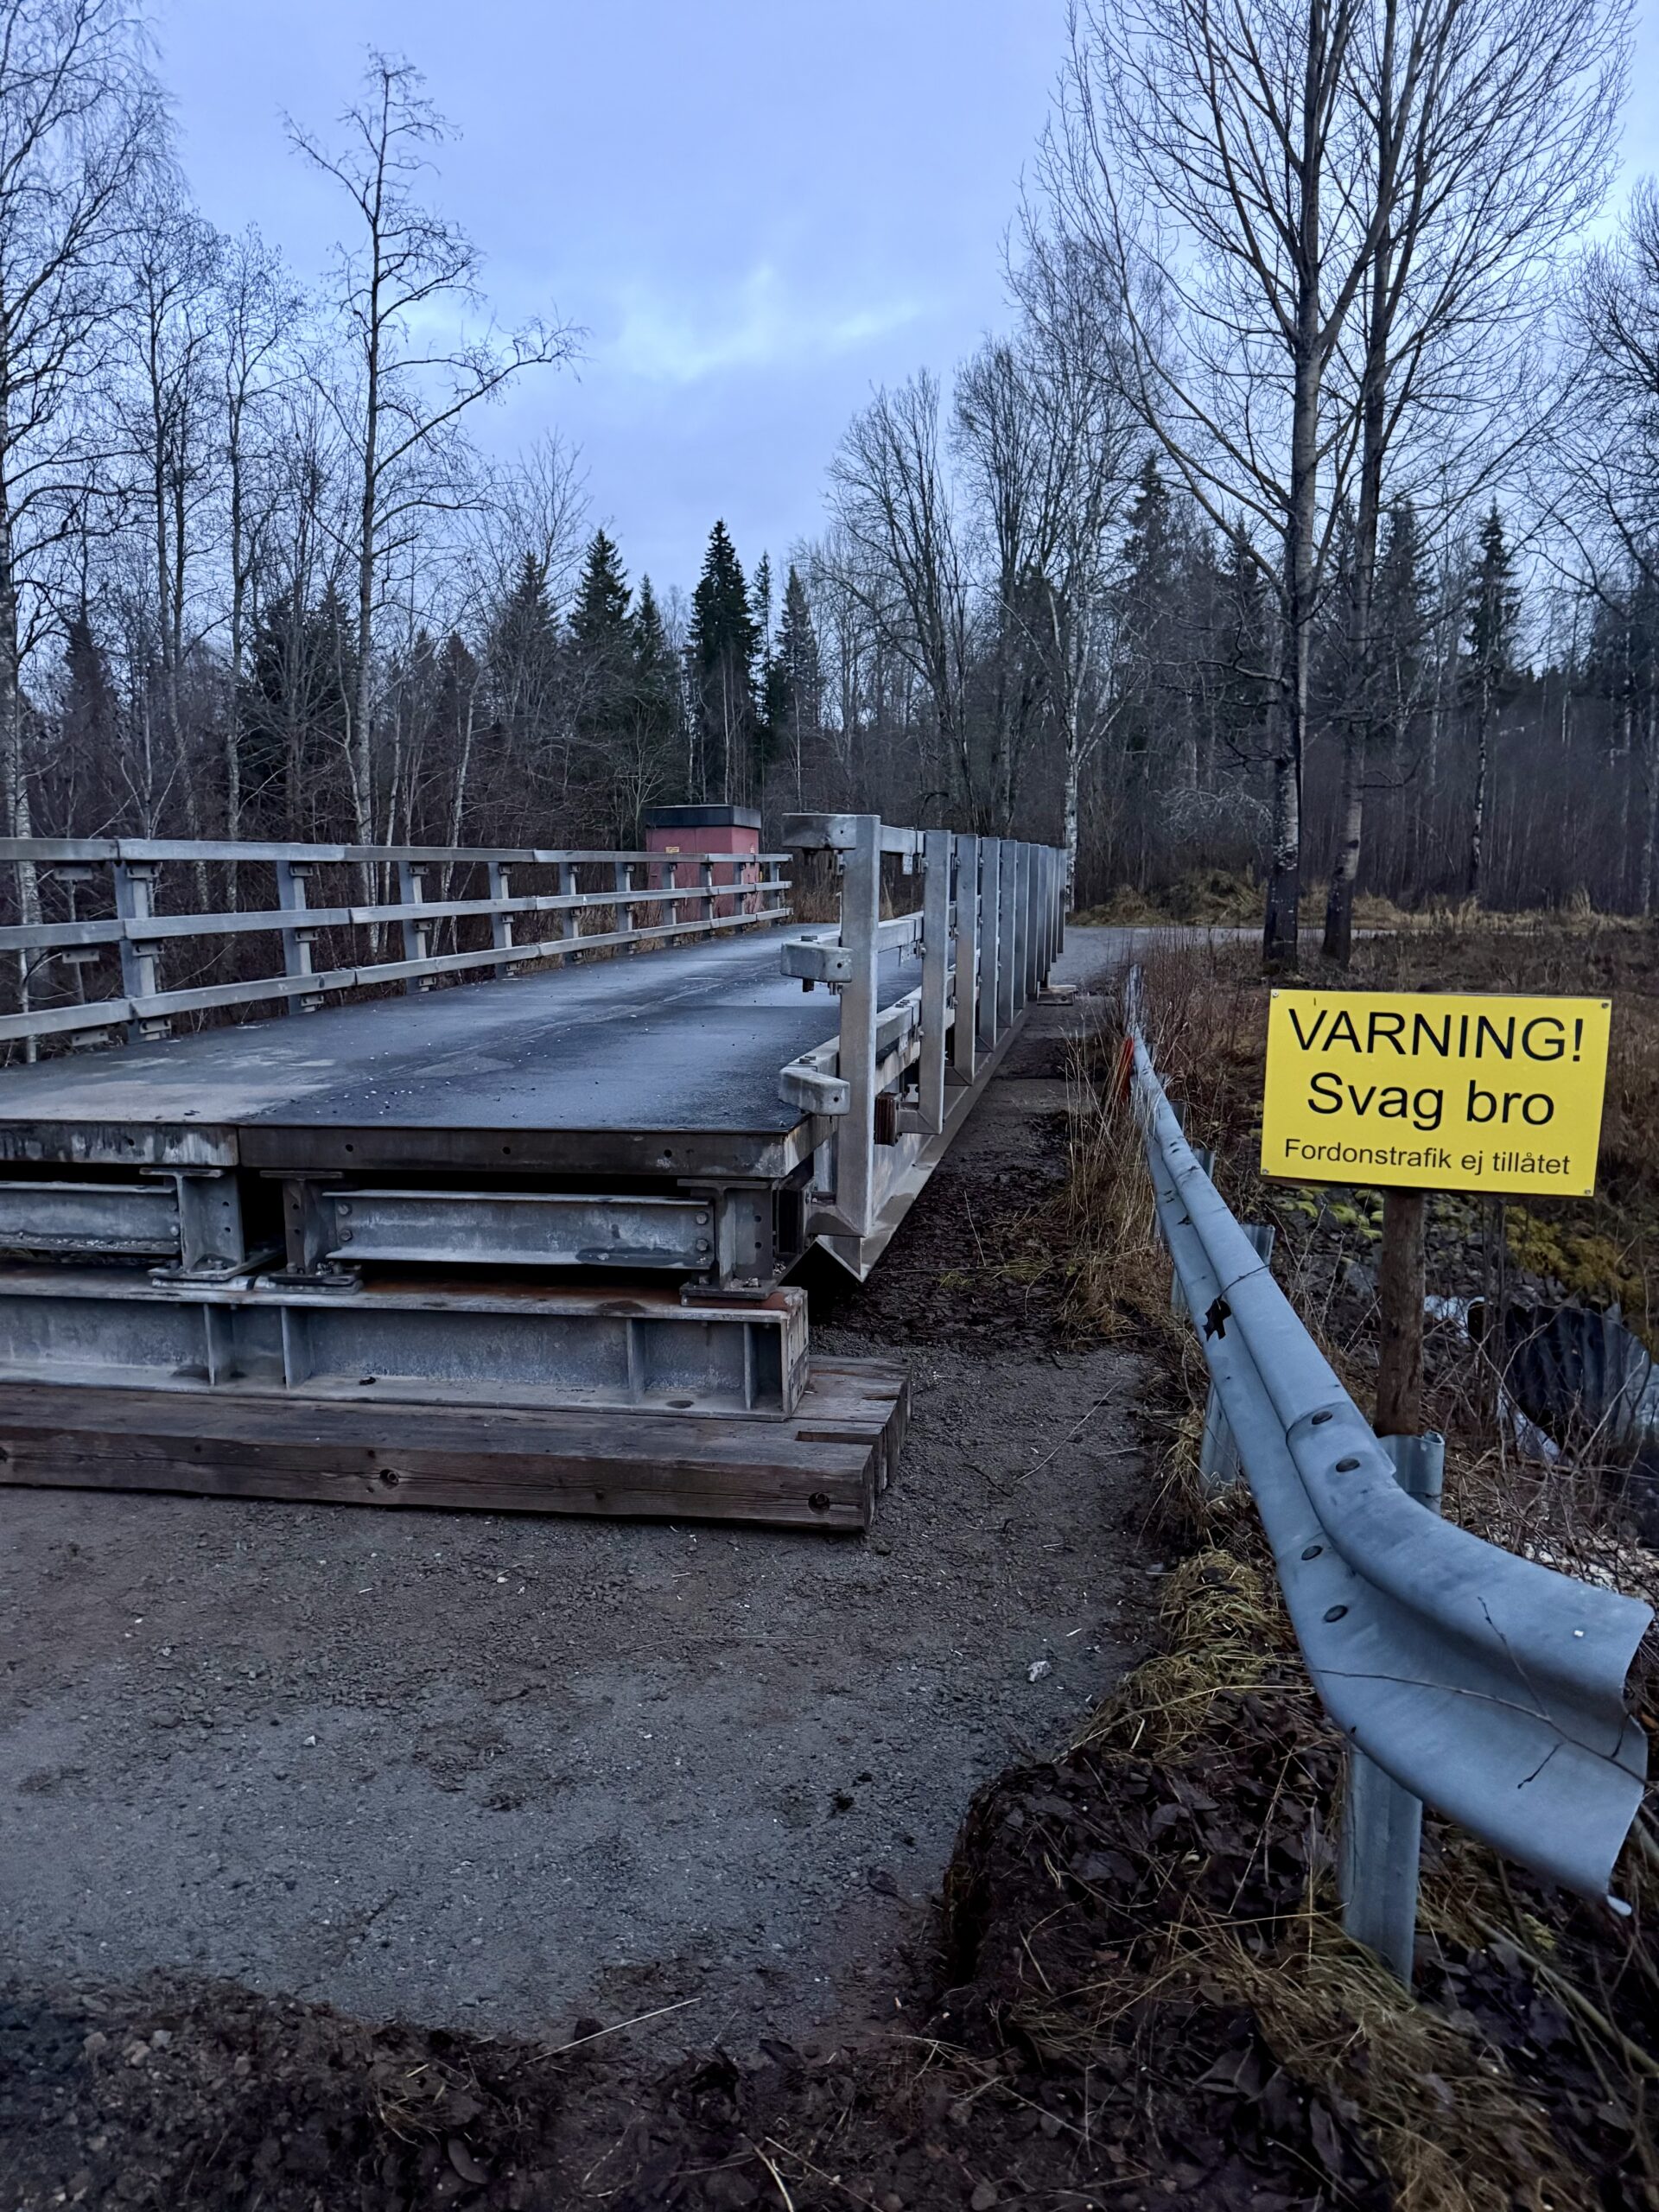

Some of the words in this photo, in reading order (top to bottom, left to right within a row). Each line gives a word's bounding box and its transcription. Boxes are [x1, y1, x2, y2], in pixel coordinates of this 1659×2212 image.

[1288, 1007, 1584, 1062] VARNING!
[1306, 1071, 1444, 1131] Svag
[1466, 1079, 1554, 1126] bro
[1284, 1138, 1452, 1169] Fordonstrafik
[1460, 1150, 1484, 1176] ej
[1492, 1151, 1571, 1175] tillåtet
